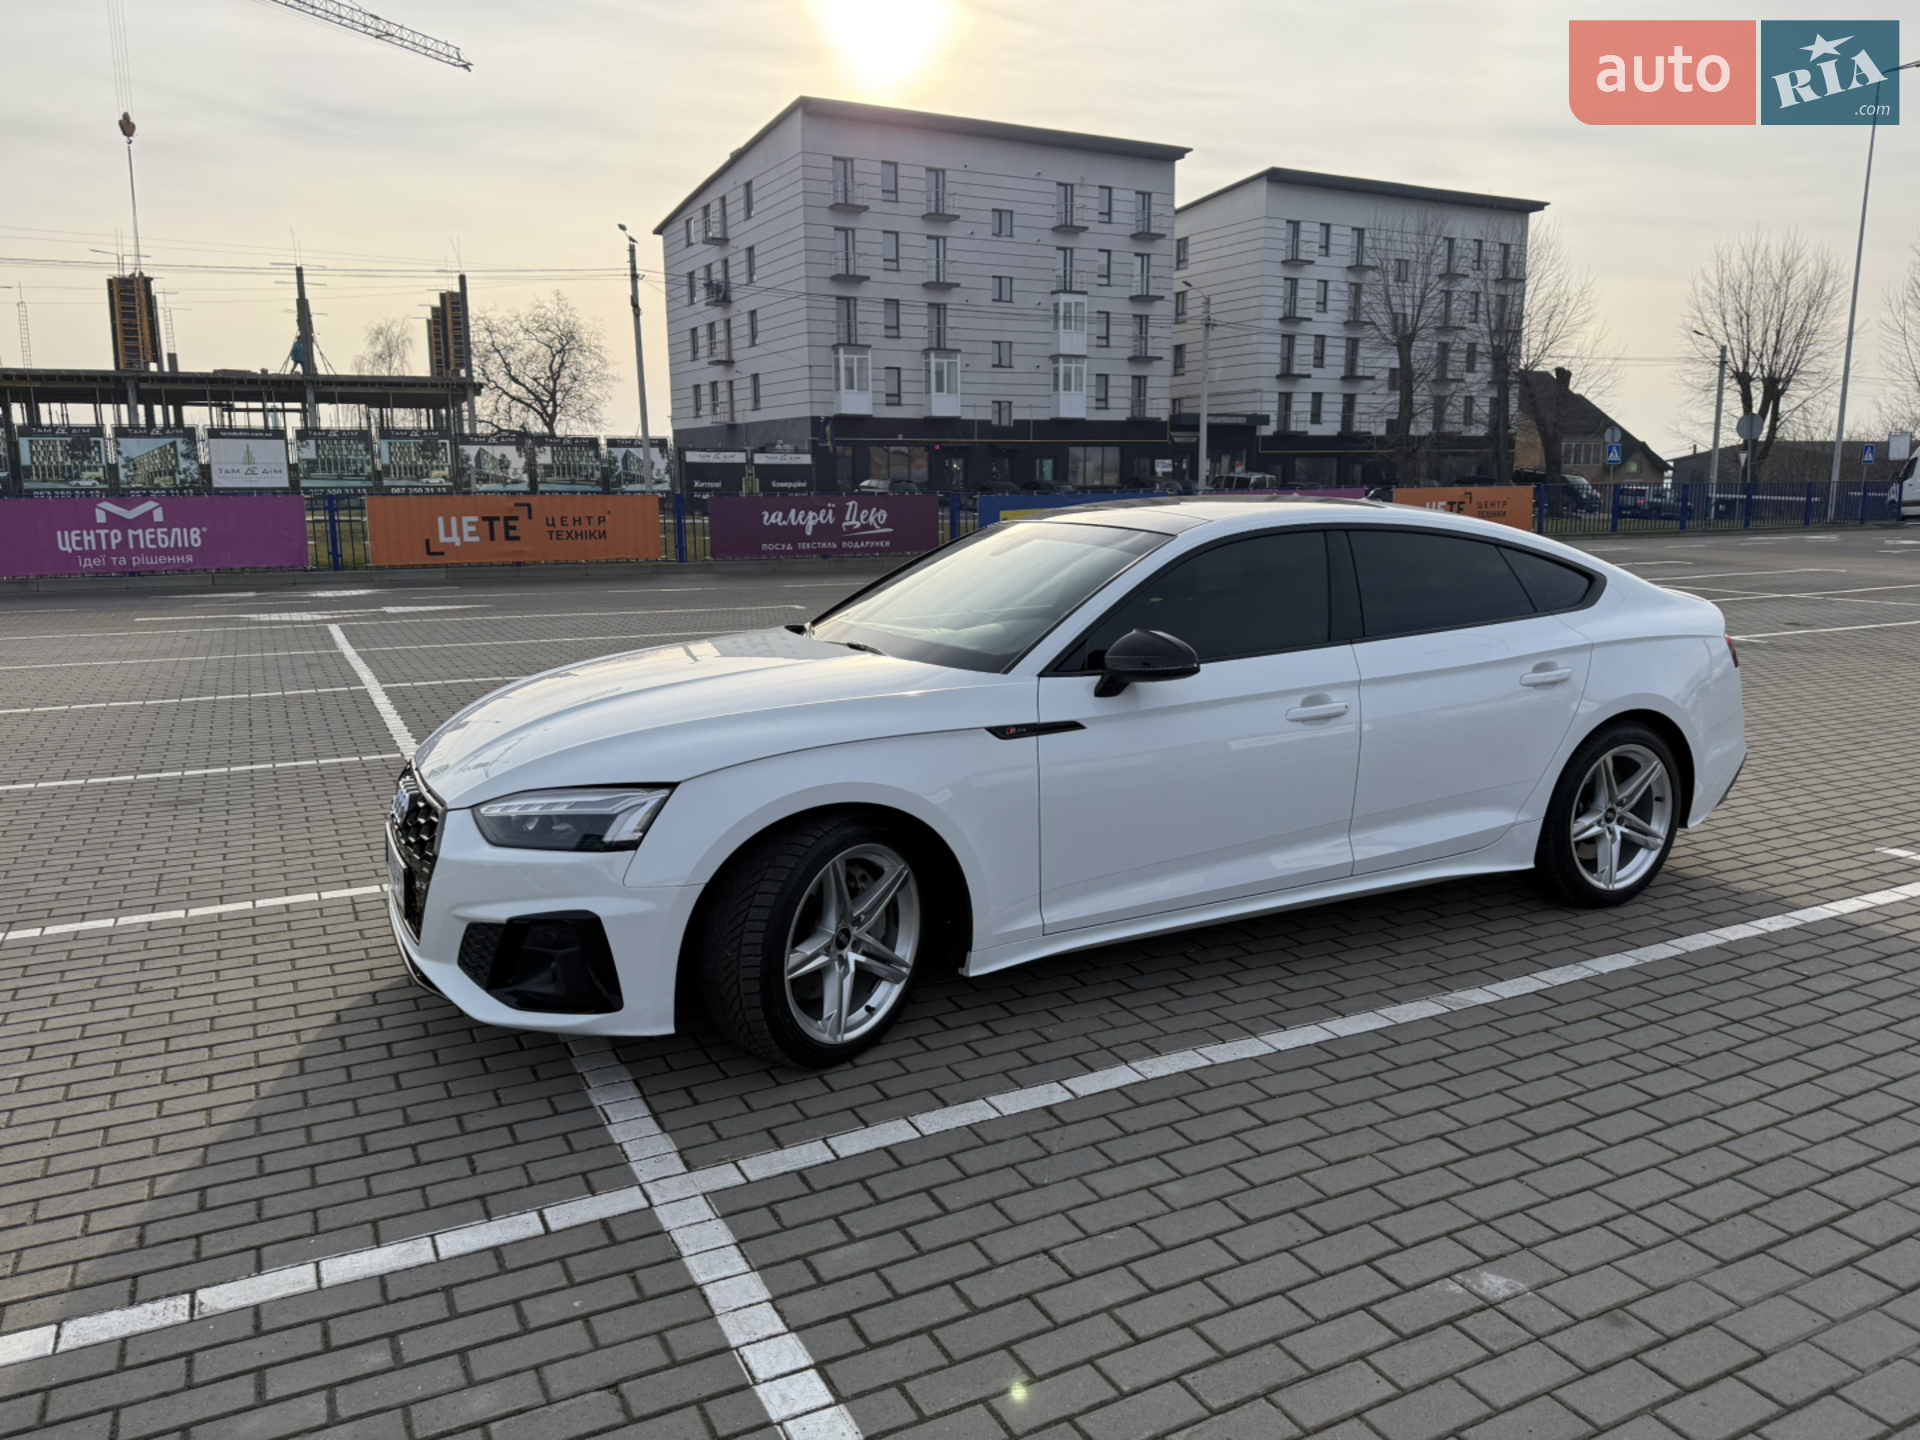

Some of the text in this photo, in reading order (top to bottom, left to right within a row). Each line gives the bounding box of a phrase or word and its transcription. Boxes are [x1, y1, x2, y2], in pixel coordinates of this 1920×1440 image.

[1477, 501, 1507, 509] ЦЕНТР
[546, 516, 606, 528] ЦЕНТР
[762, 500, 888, 536] галереї Деко
[437, 516, 521, 546] ЦЕТЕ
[547, 530, 607, 540] ТЕХНІКИ
[56, 527, 202, 553] ЦЕНТР МЕБЛІВ
[78, 553, 193, 569] ідеї та рішення
